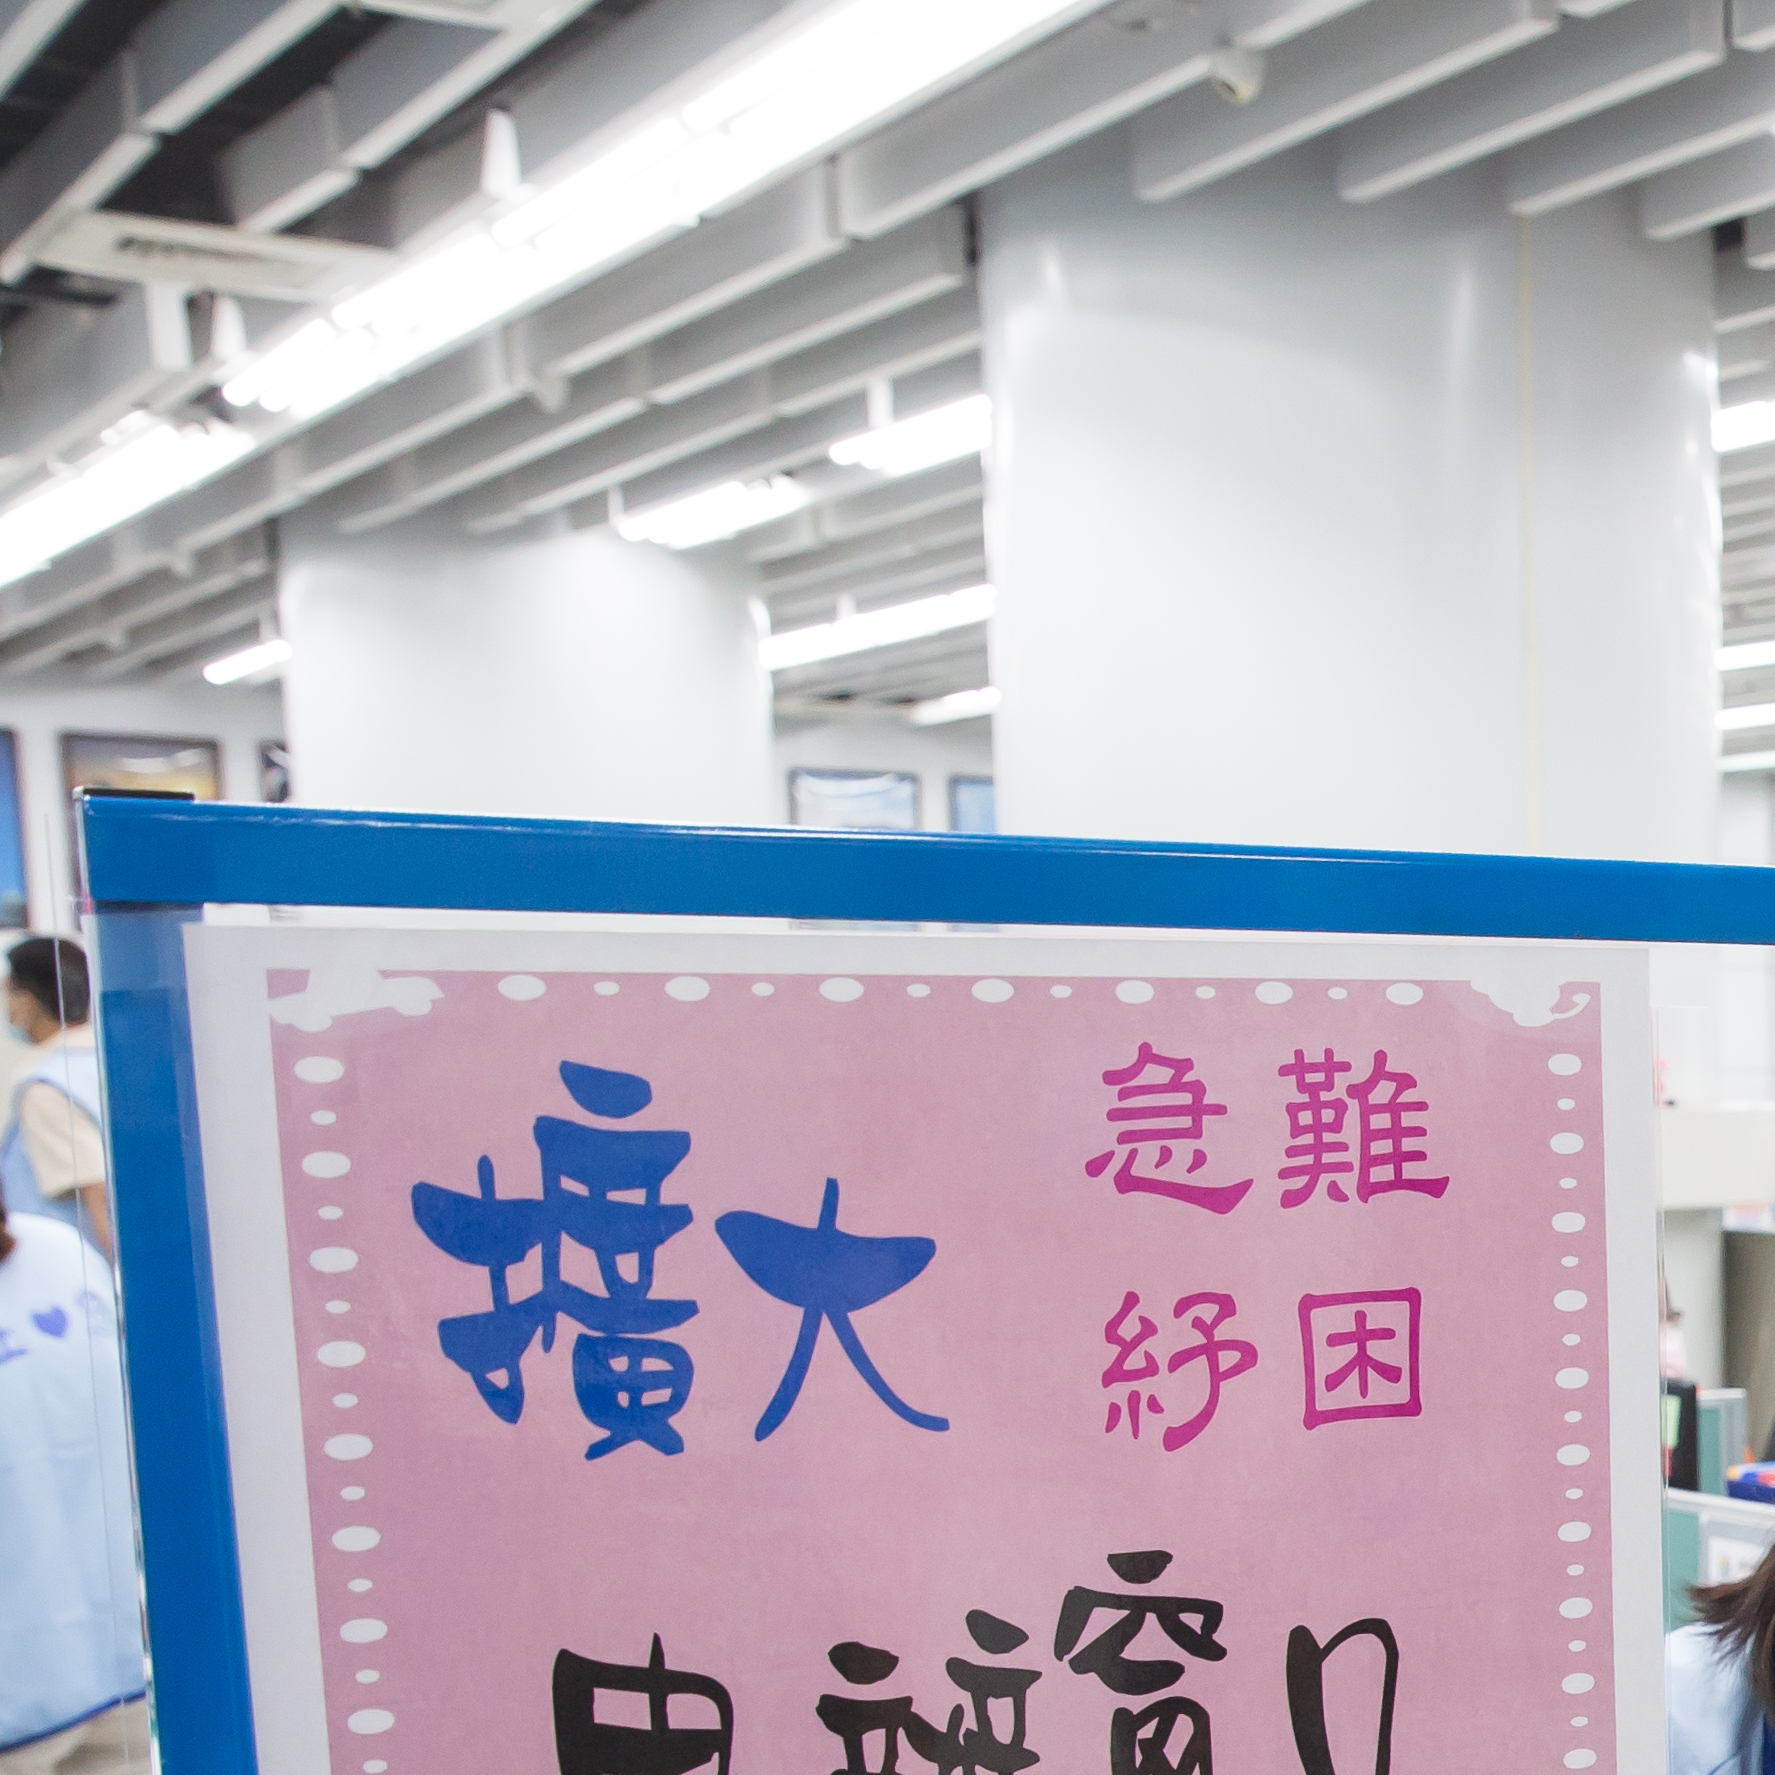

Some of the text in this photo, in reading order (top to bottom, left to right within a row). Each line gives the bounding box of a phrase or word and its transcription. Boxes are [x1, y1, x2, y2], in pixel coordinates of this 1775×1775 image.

[1085, 1041, 1450, 1214] 急難
[411, 1060, 950, 1460] 擴大
[1101, 1287, 1423, 1453] 紓困
